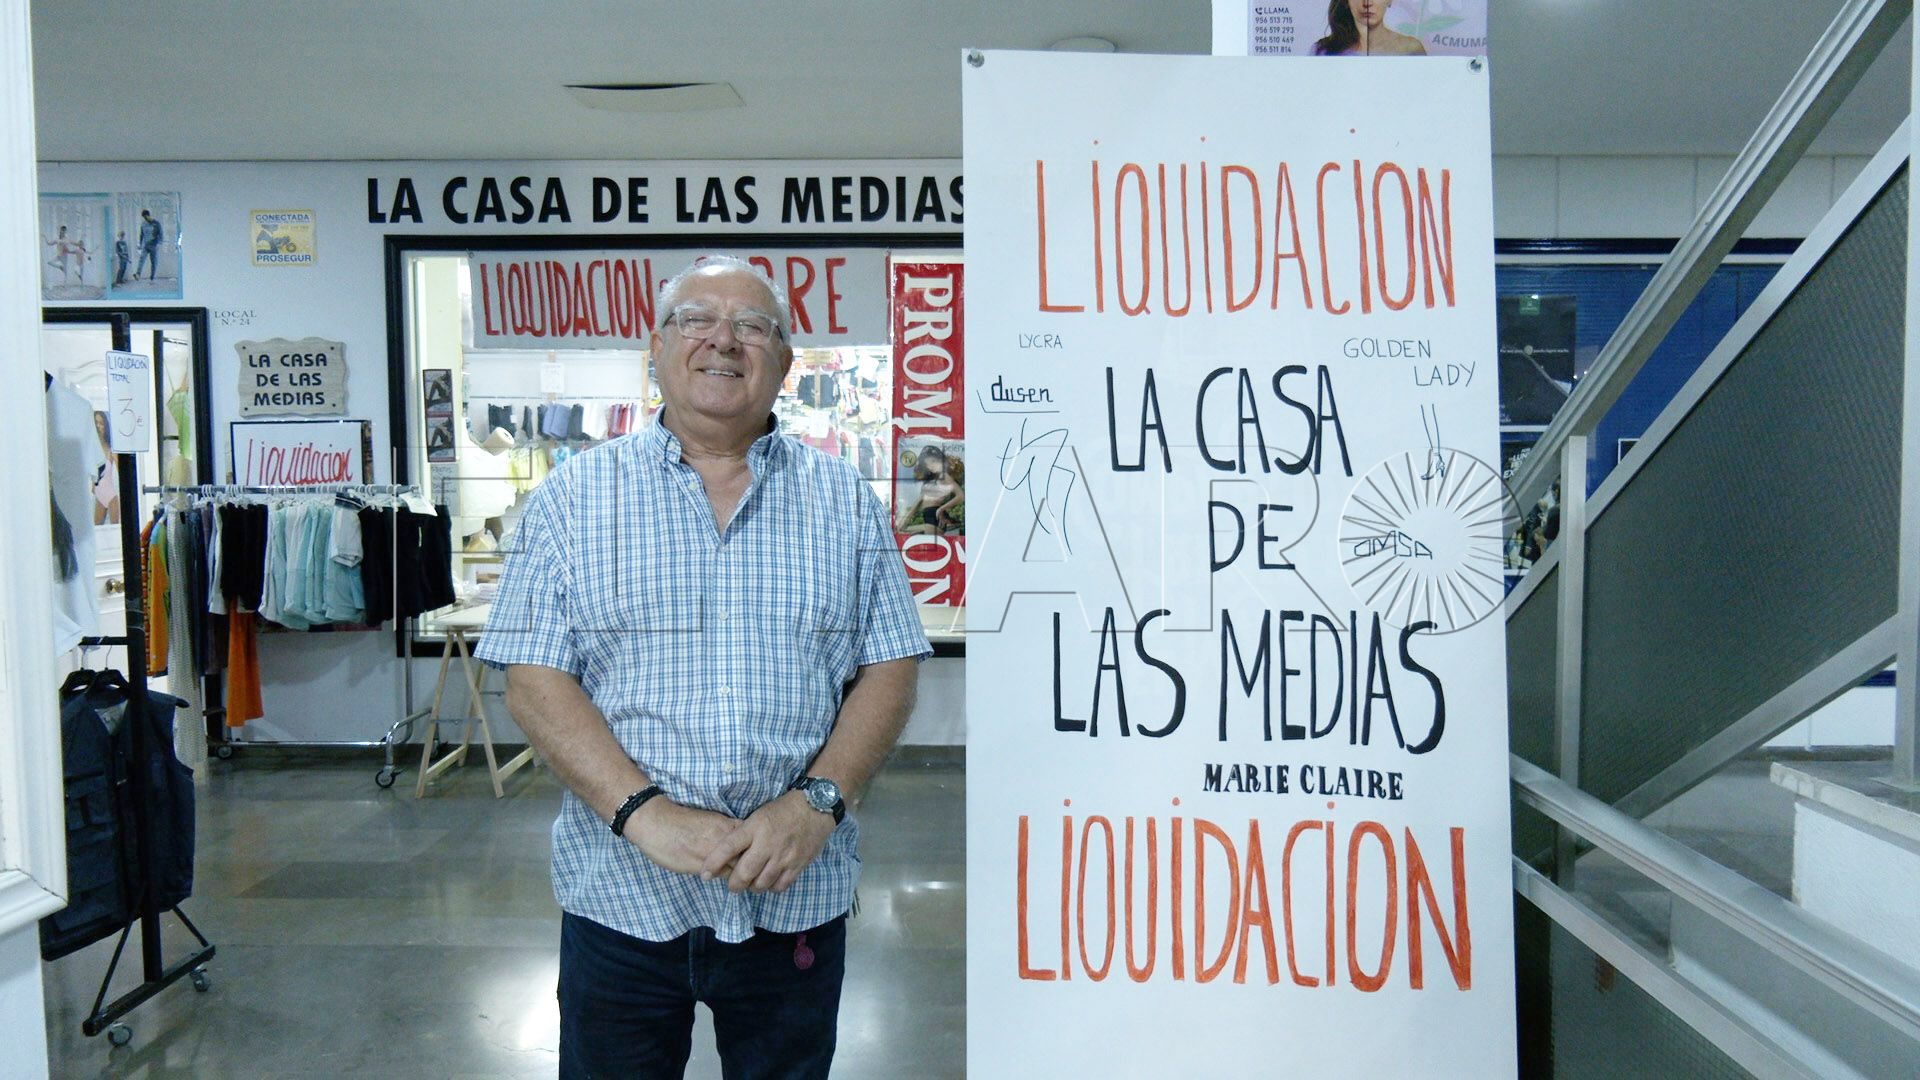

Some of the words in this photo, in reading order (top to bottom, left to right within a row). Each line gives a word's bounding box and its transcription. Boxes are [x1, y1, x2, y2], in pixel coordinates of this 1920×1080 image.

[1255, 26, 1268, 34] 956
[367, 176, 424, 224] LA
[442, 175, 572, 225] CASA
[592, 176, 649, 224] DE
[675, 175, 759, 224] LAS
[256, 254, 311, 262] PROSEGUR
[480, 258, 655, 339] LIQUIDACION
[214, 310, 257, 318] LOCAL
[1018, 334, 1063, 349] LYCRA
[1343, 337, 1431, 359] GOLDEN
[249, 354, 271, 368] LA
[280, 353, 328, 367] CASA
[256, 373, 280, 387] DE
[289, 372, 322, 387] LAS
[1414, 361, 1476, 387] LADY
[253, 391, 325, 406] MEDIAS
[1106, 366, 1173, 474] LA
[1195, 364, 1353, 477] CASA
[1208, 500, 1296, 573] DE
[1053, 606, 1187, 738] LAS
[1218, 608, 1446, 755] MEDIAS
[1202, 763, 1290, 795] MARIE
[1300, 764, 1404, 801] CLAIRE
